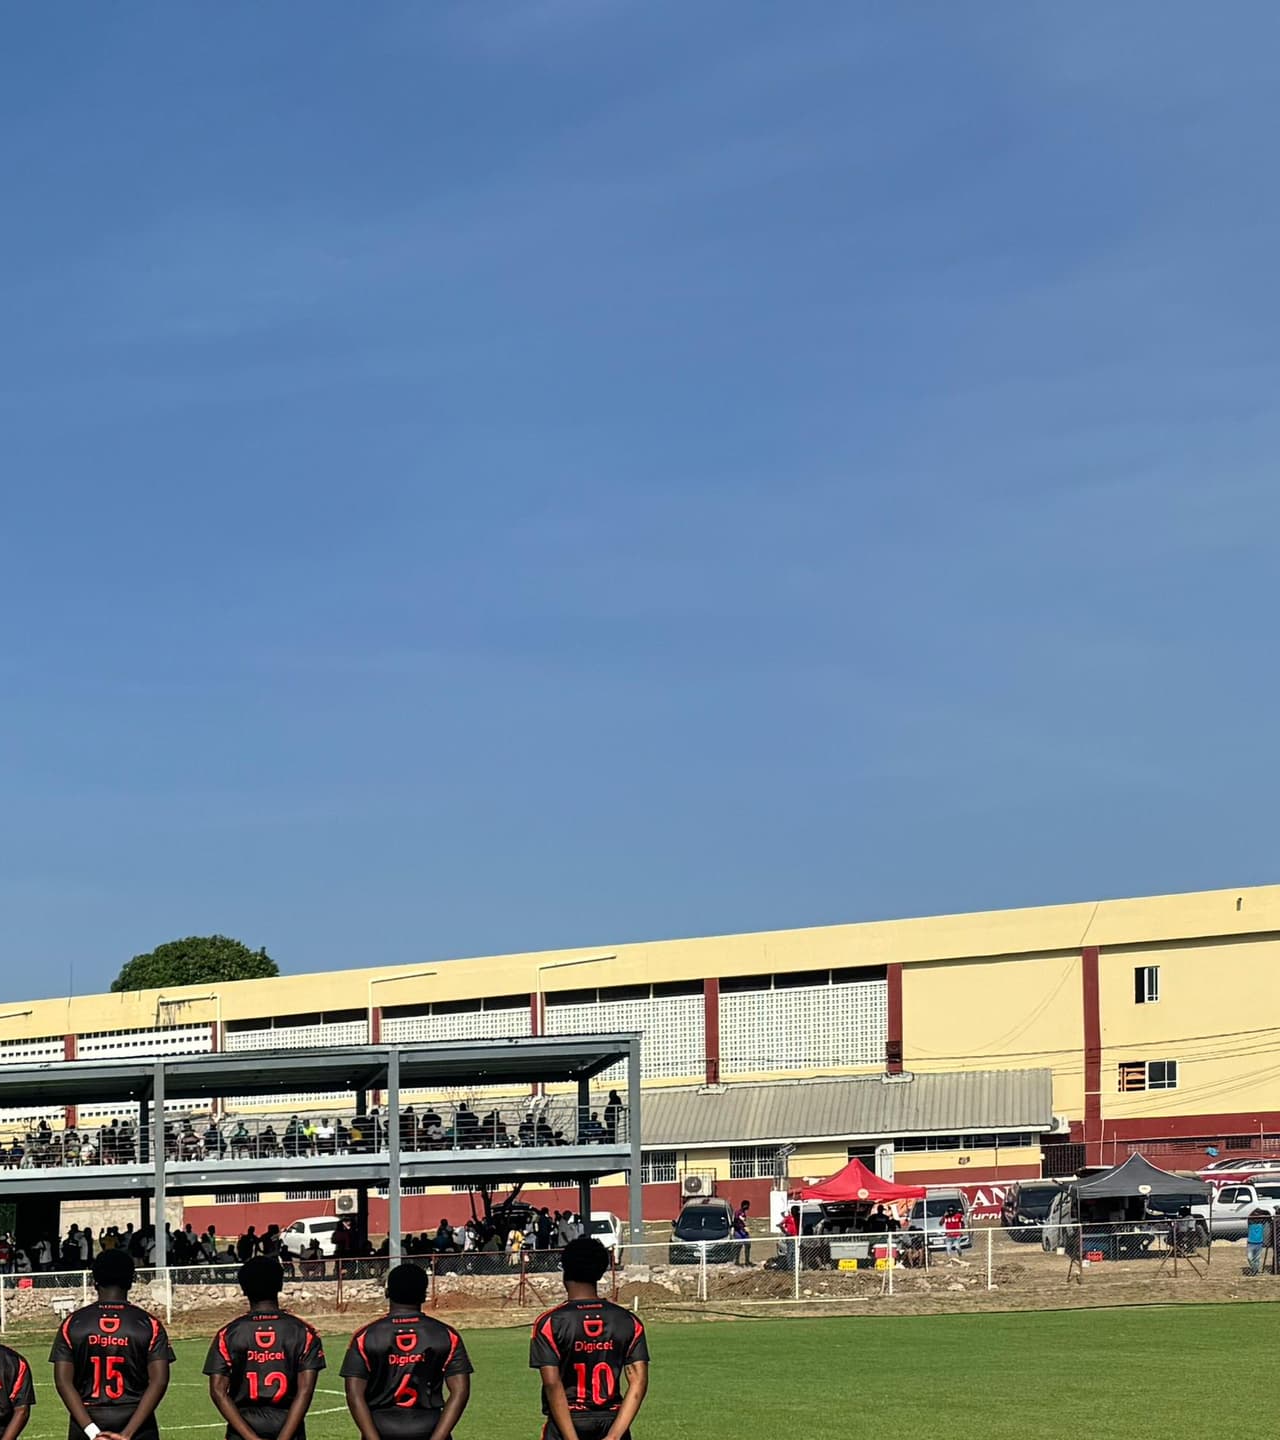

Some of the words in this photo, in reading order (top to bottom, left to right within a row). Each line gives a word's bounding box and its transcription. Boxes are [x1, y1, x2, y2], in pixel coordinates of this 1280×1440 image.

[963, 1186, 1010, 1207] AN
[88, 1334, 128, 1348] Digicel
[574, 1339, 613, 1353] Digicel
[247, 1351, 285, 1363] Digicel
[90, 1355, 125, 1400] 15
[246, 1371, 288, 1404] 12
[394, 1373, 419, 1408] 6
[573, 1362, 615, 1406] 10
